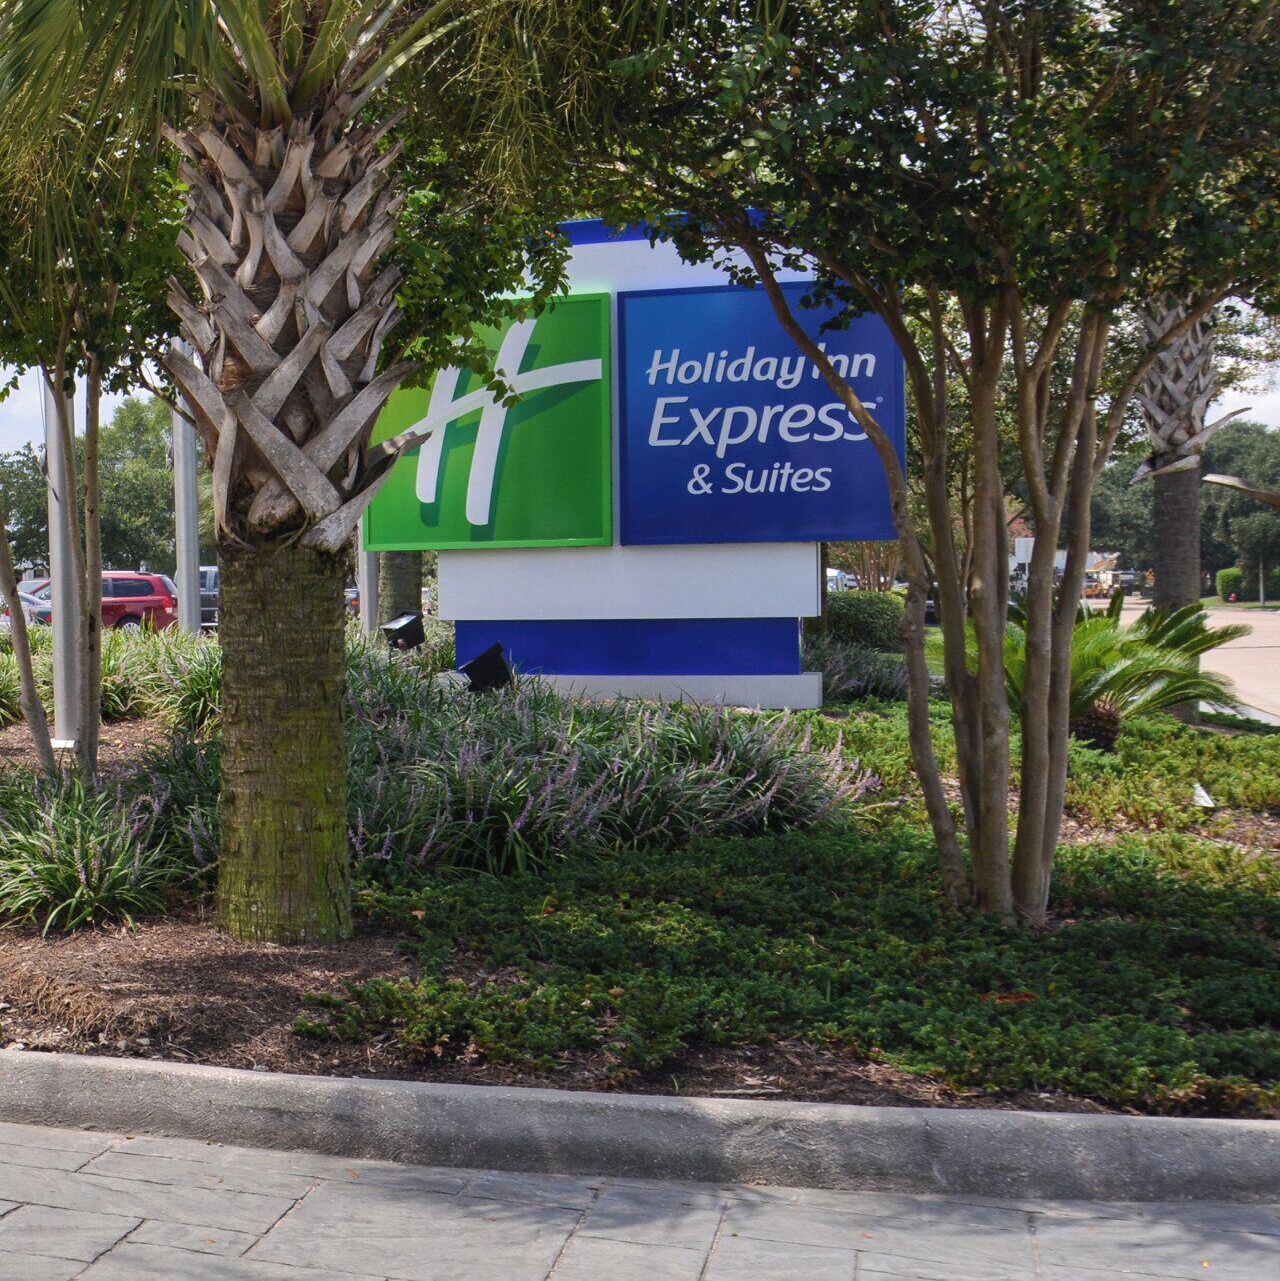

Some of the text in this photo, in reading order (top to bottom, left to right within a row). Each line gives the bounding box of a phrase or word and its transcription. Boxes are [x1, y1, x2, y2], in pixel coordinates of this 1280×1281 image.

[646, 346, 806, 390] Holiday
[648, 396, 877, 459] Express
[687, 462, 833, 495] & Suites
